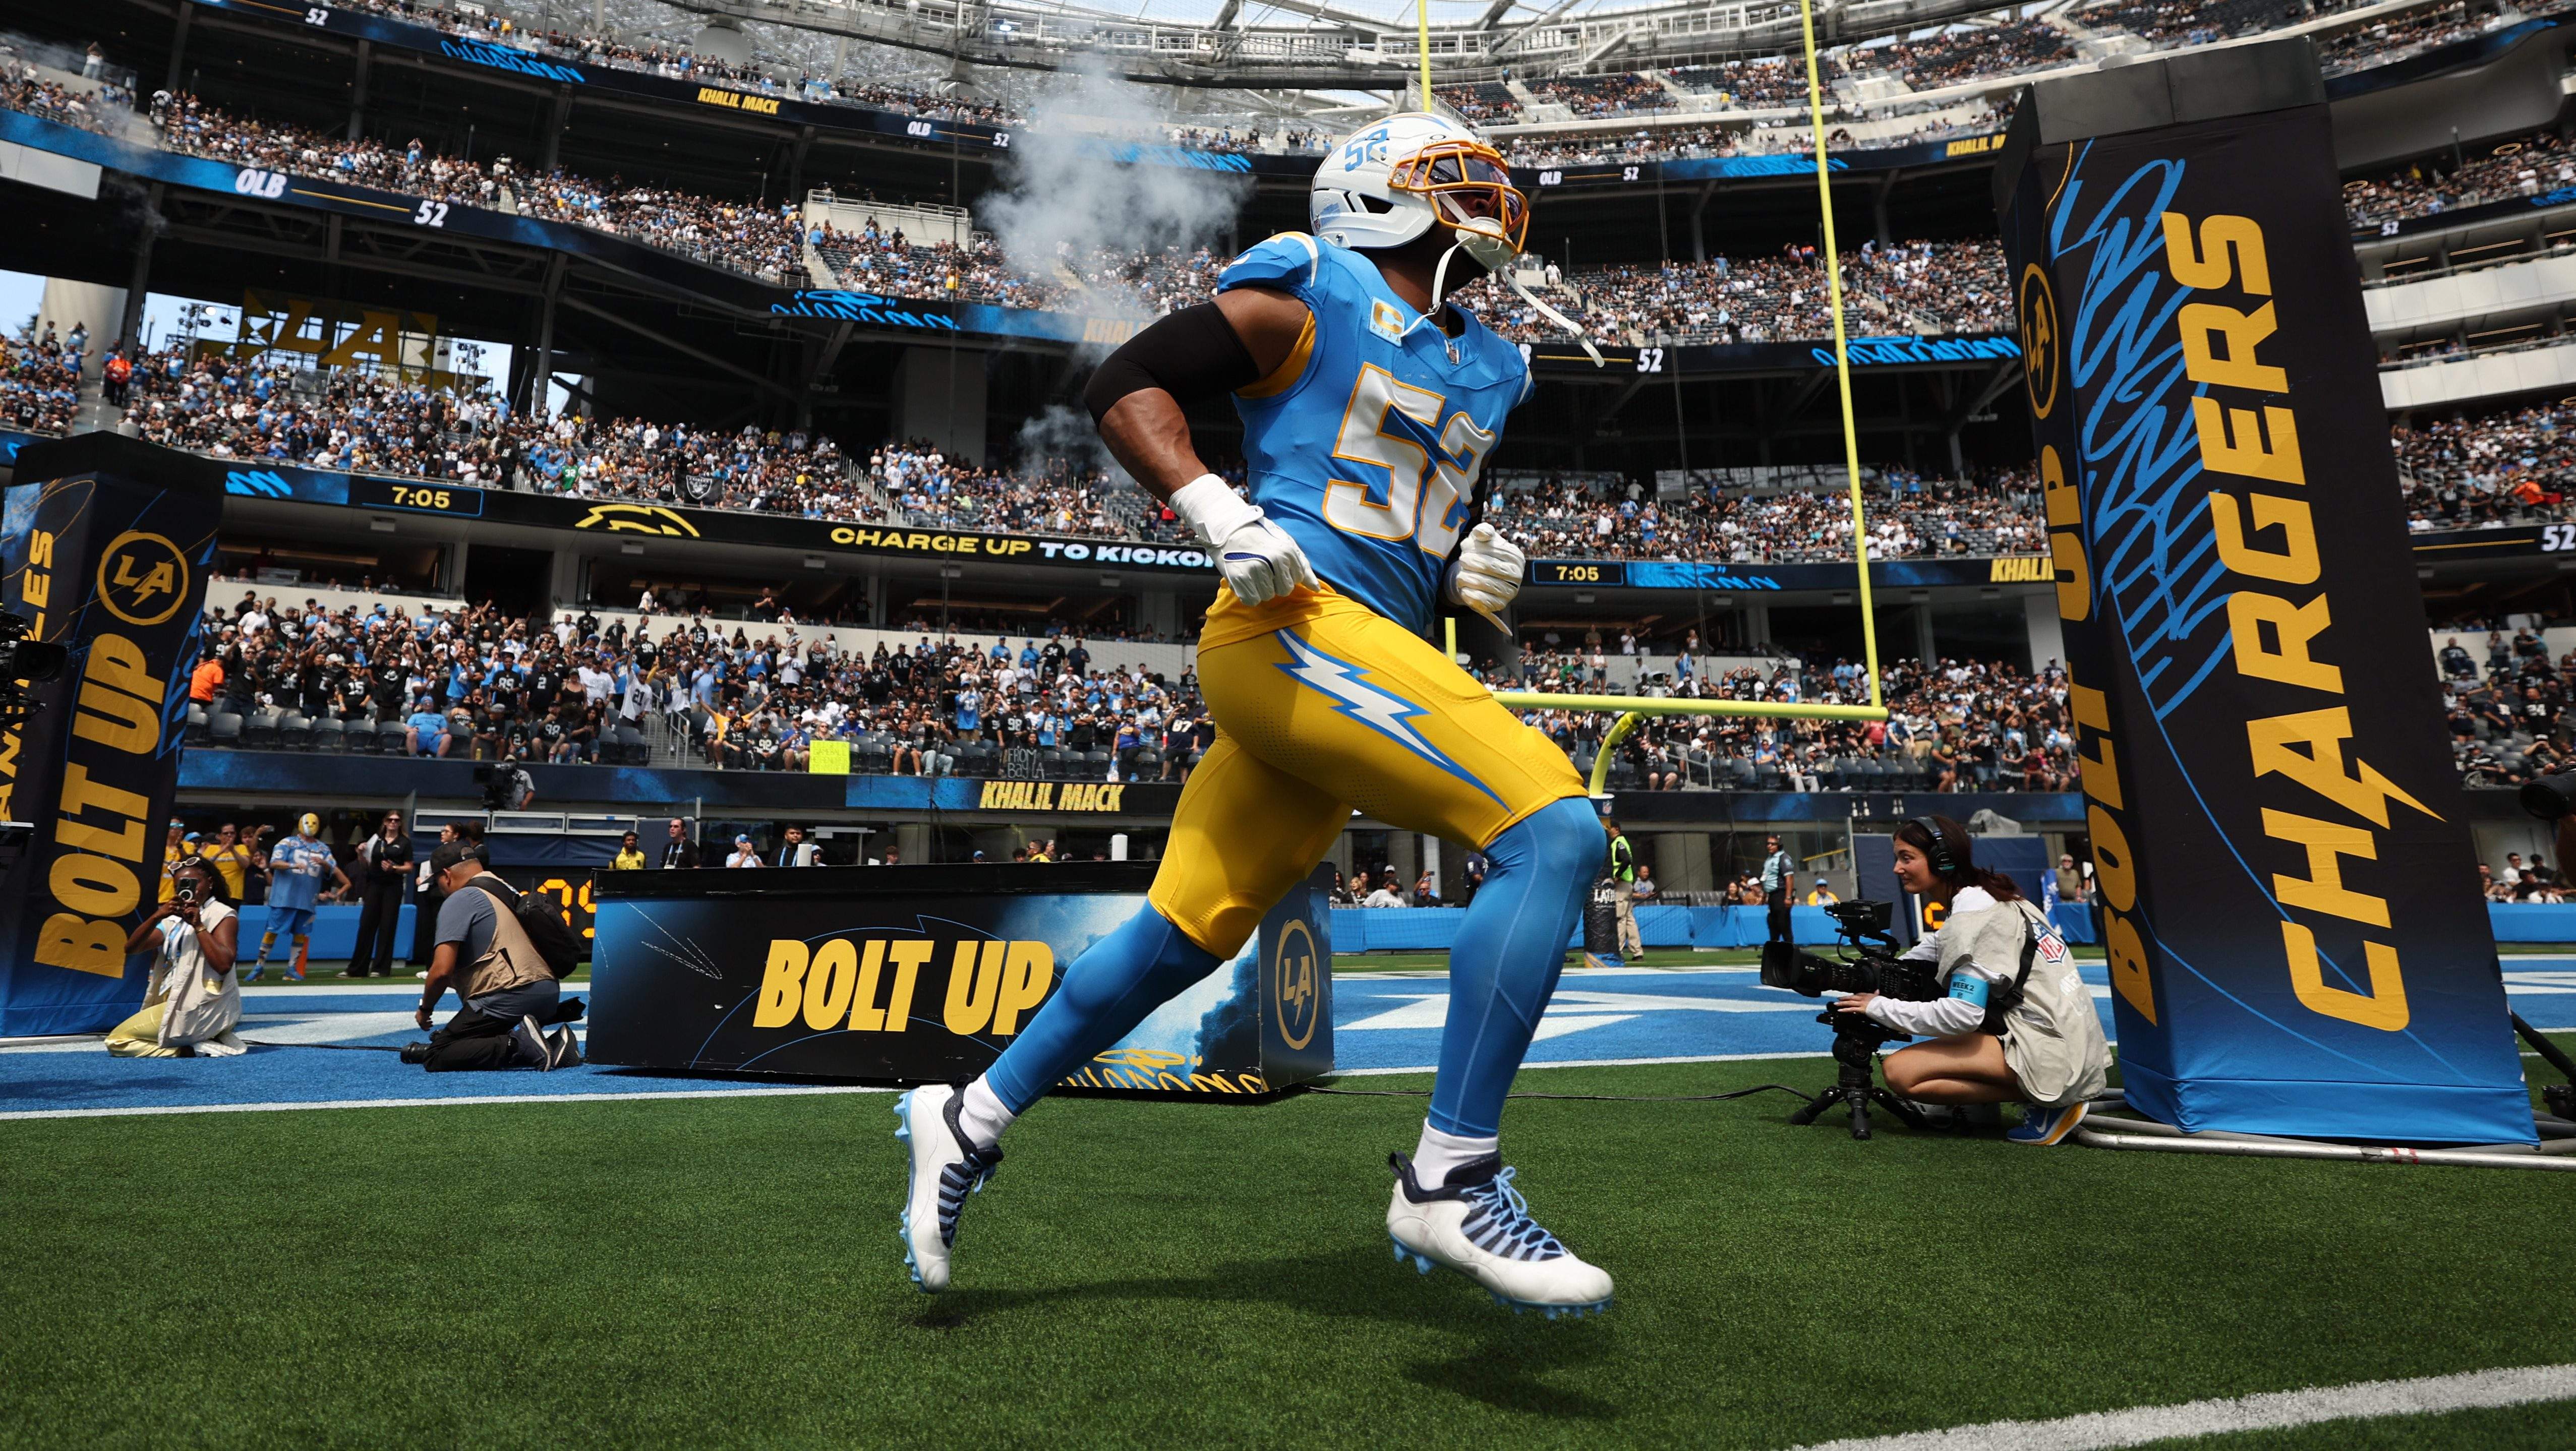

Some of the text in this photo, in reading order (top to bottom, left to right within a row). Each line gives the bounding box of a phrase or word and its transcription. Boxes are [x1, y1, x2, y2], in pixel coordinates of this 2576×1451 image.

[305, 8, 328, 26] 52
[697, 87, 780, 114] KHALIL MACK
[907, 120, 932, 137] OLB
[993, 132, 1010, 147] 52
[1947, 137, 1989, 157] KHALIL
[235, 168, 287, 199] OLB
[1539, 170, 1562, 186] OLB
[1623, 166, 1640, 181] 52
[414, 200, 449, 227] 52
[1636, 348, 1664, 373] 52
[1322, 361, 1496, 560] 52
[392, 486, 450, 509] 7:05
[830, 527, 980, 554] CHARGE
[985, 538, 1032, 556] UP
[1038, 541, 1090, 560] TO
[2541, 524, 2575, 552] 52
[112, 555, 174, 607] LA
[1556, 565, 1600, 582] 7:05
[2160, 211, 2445, 1032] CHARGERS
[1172, 720, 1192, 733] 87
[2040, 445, 2157, 1027] BOLT UP
[34, 633, 165, 979] BOLT UP
[980, 781, 1125, 812] KHALIL MACK
[752, 938, 1055, 1036] BOLT UP
[1283, 956, 1311, 1026] LA
[1952, 982, 1969, 990] WEEK
